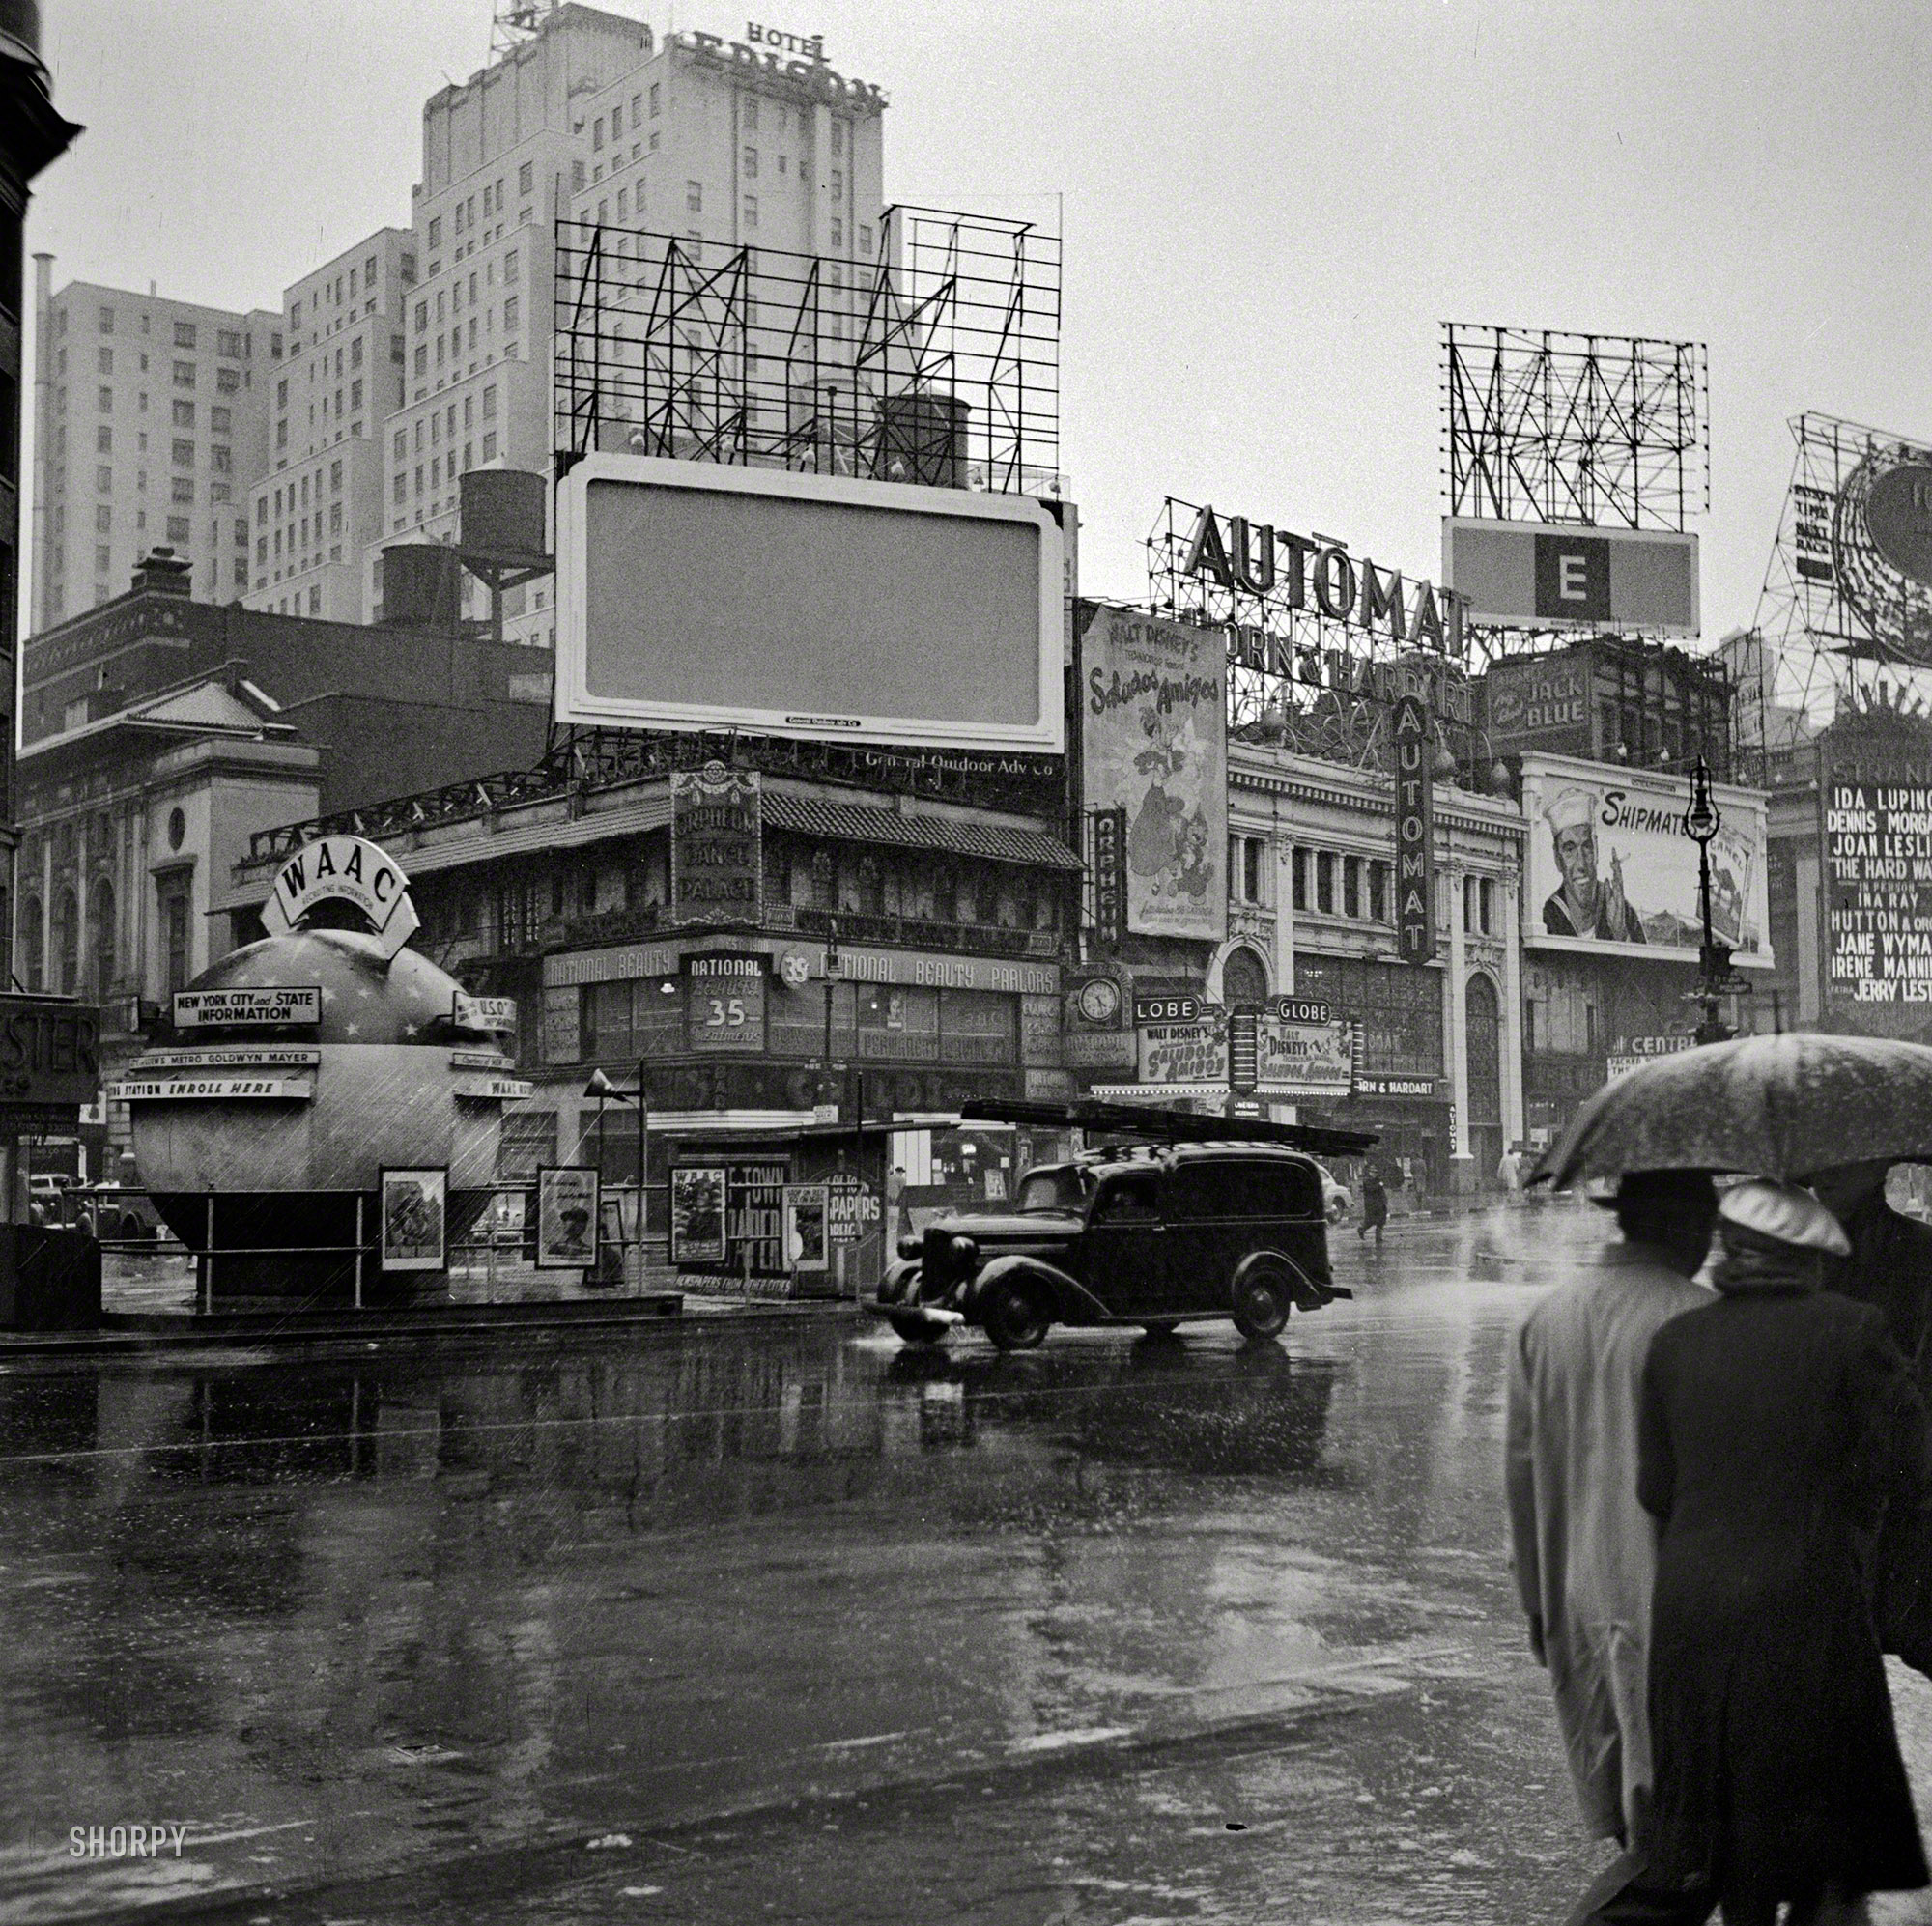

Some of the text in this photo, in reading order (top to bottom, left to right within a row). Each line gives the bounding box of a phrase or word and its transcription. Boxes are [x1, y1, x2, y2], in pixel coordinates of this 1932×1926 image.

[748, 21, 831, 63] HOTEL
[1184, 504, 1474, 659] AUTOMAT
[1558, 555, 1587, 601] E
[1528, 700, 1584, 728] BLUE
[866, 751, 924, 770] Genral
[931, 755, 993, 772] Outdoor
[998, 759, 1027, 775] Adv
[1834, 787, 1866, 810] IDA
[1398, 705, 1425, 951] AUTOMAT
[1827, 809, 1878, 834] DENNIS
[1833, 834, 1878, 858] JOAN
[282, 842, 396, 903] WAAC
[1865, 858, 1908, 881] HARD
[1912, 858, 1932, 881] WA
[1858, 892, 1918, 911] INA RAY
[1831, 910, 1899, 932] HUTTON
[1836, 932, 1876, 955] JANE
[550, 949, 671, 986] NATIONAL BEAUTY
[691, 959, 763, 977] NATIONAL
[821, 951, 1053, 994] NTIONAL BEAUTY PARLORS
[1832, 955, 1874, 978] IRENE
[178, 992, 313, 1010] NEW YORK CITY and STATE
[1853, 979, 1898, 1002] JERRY
[198, 1006, 292, 1022] INFORMATION
[706, 999, 745, 1026] 35
[1280, 1003, 1327, 1021] GLOBE
[1147, 1027, 1208, 1040] WALT DISNEY'S
[1279, 1027, 1300, 1041] WALT
[171, 1054, 202, 1063] METRO
[209, 1053, 263, 1063] GOLDWYN
[269, 1052, 308, 1062] MAYER
[1270, 1036, 1308, 1057] DISNEY'S
[125, 1084, 161, 1095] STATION
[169, 1084, 222, 1095] ENROLL
[231, 1082, 274, 1094] HERE
[1378, 1082, 1386, 1093] &
[1389, 1082, 1433, 1094] HARDART
[675, 1171, 724, 1184] WAAC
[742, 1166, 784, 1205] TOWN
[676, 1274, 722, 1289] NEWSPAPERS
[722, 1277, 743, 1290] FROM
